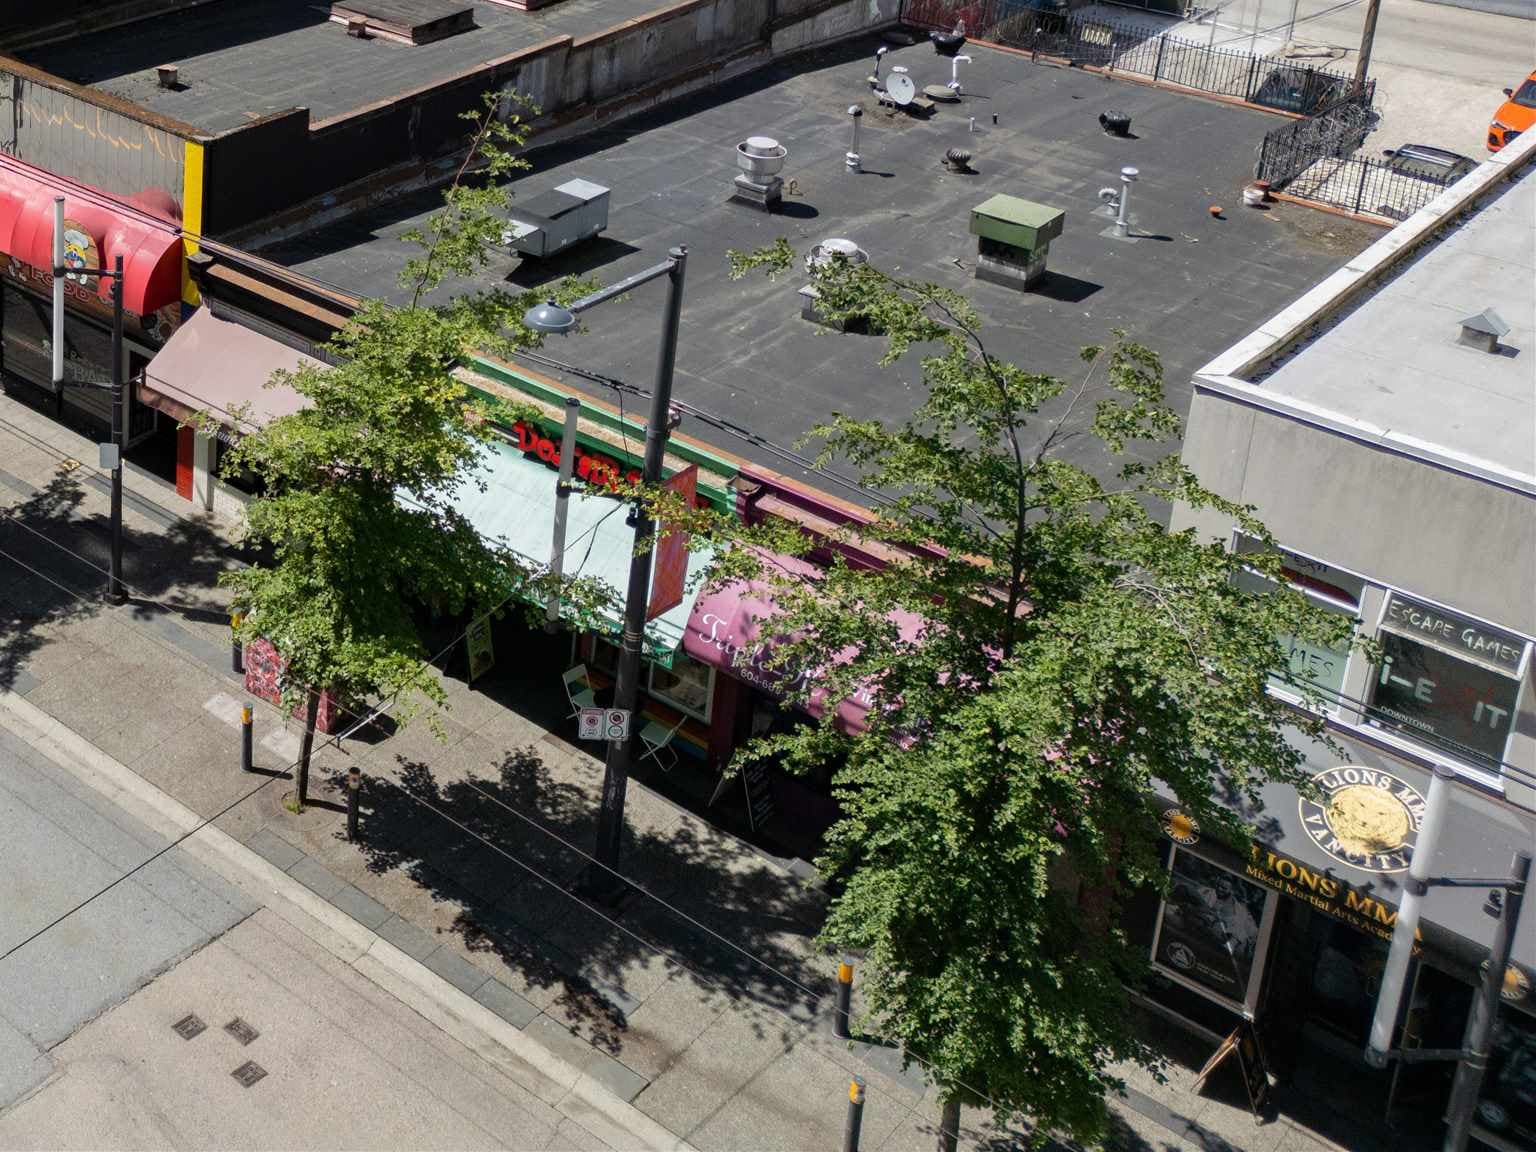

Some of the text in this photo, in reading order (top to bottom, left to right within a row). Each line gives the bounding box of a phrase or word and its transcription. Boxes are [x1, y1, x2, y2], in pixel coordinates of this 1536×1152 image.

[1388, 598, 1521, 662] ESCAPE GAMES
[1379, 704, 1435, 733] DOWNTOWN
[1321, 767, 1392, 790] LIONS
[1305, 813, 1410, 870] VANCITY
[1246, 864, 1283, 892] Mixed
[1285, 883, 1330, 913] Martial
[1332, 906, 1360, 926] Arts
